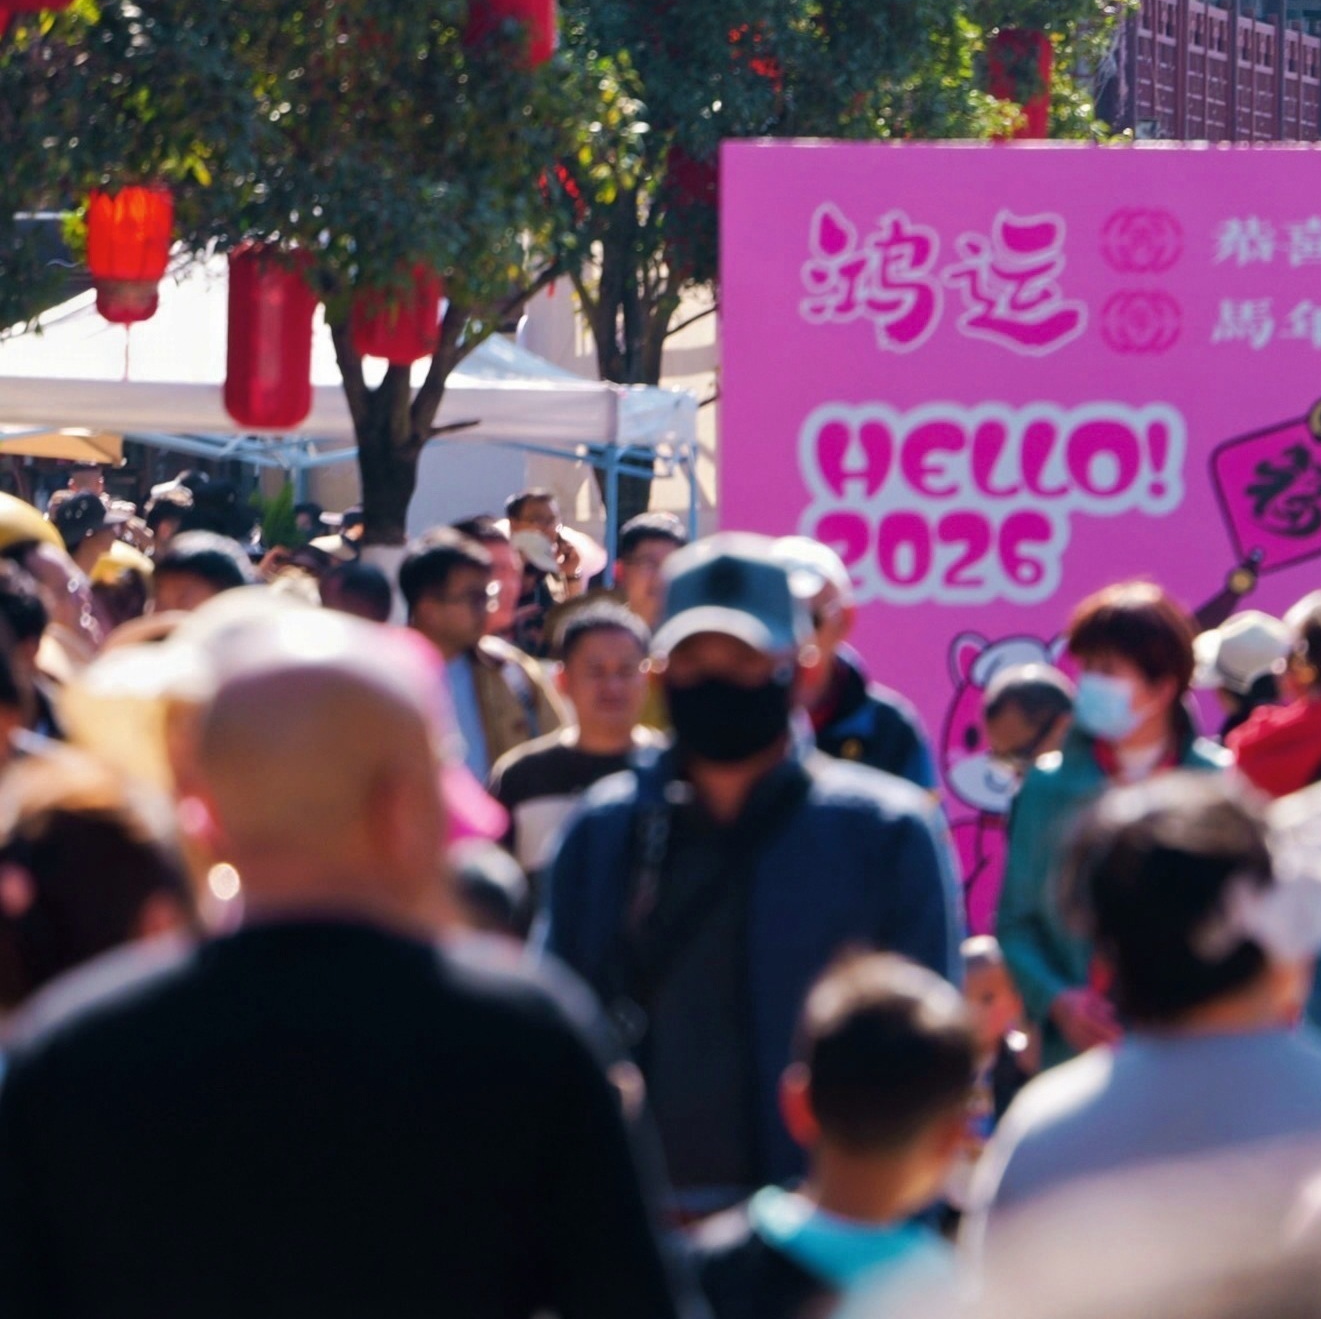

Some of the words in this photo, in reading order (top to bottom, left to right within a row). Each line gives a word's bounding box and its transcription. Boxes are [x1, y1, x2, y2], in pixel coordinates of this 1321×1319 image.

[803, 204, 1085, 354] 鸿运
[808, 413, 1176, 505] HELLO!
[806, 507, 1060, 592] 2026
